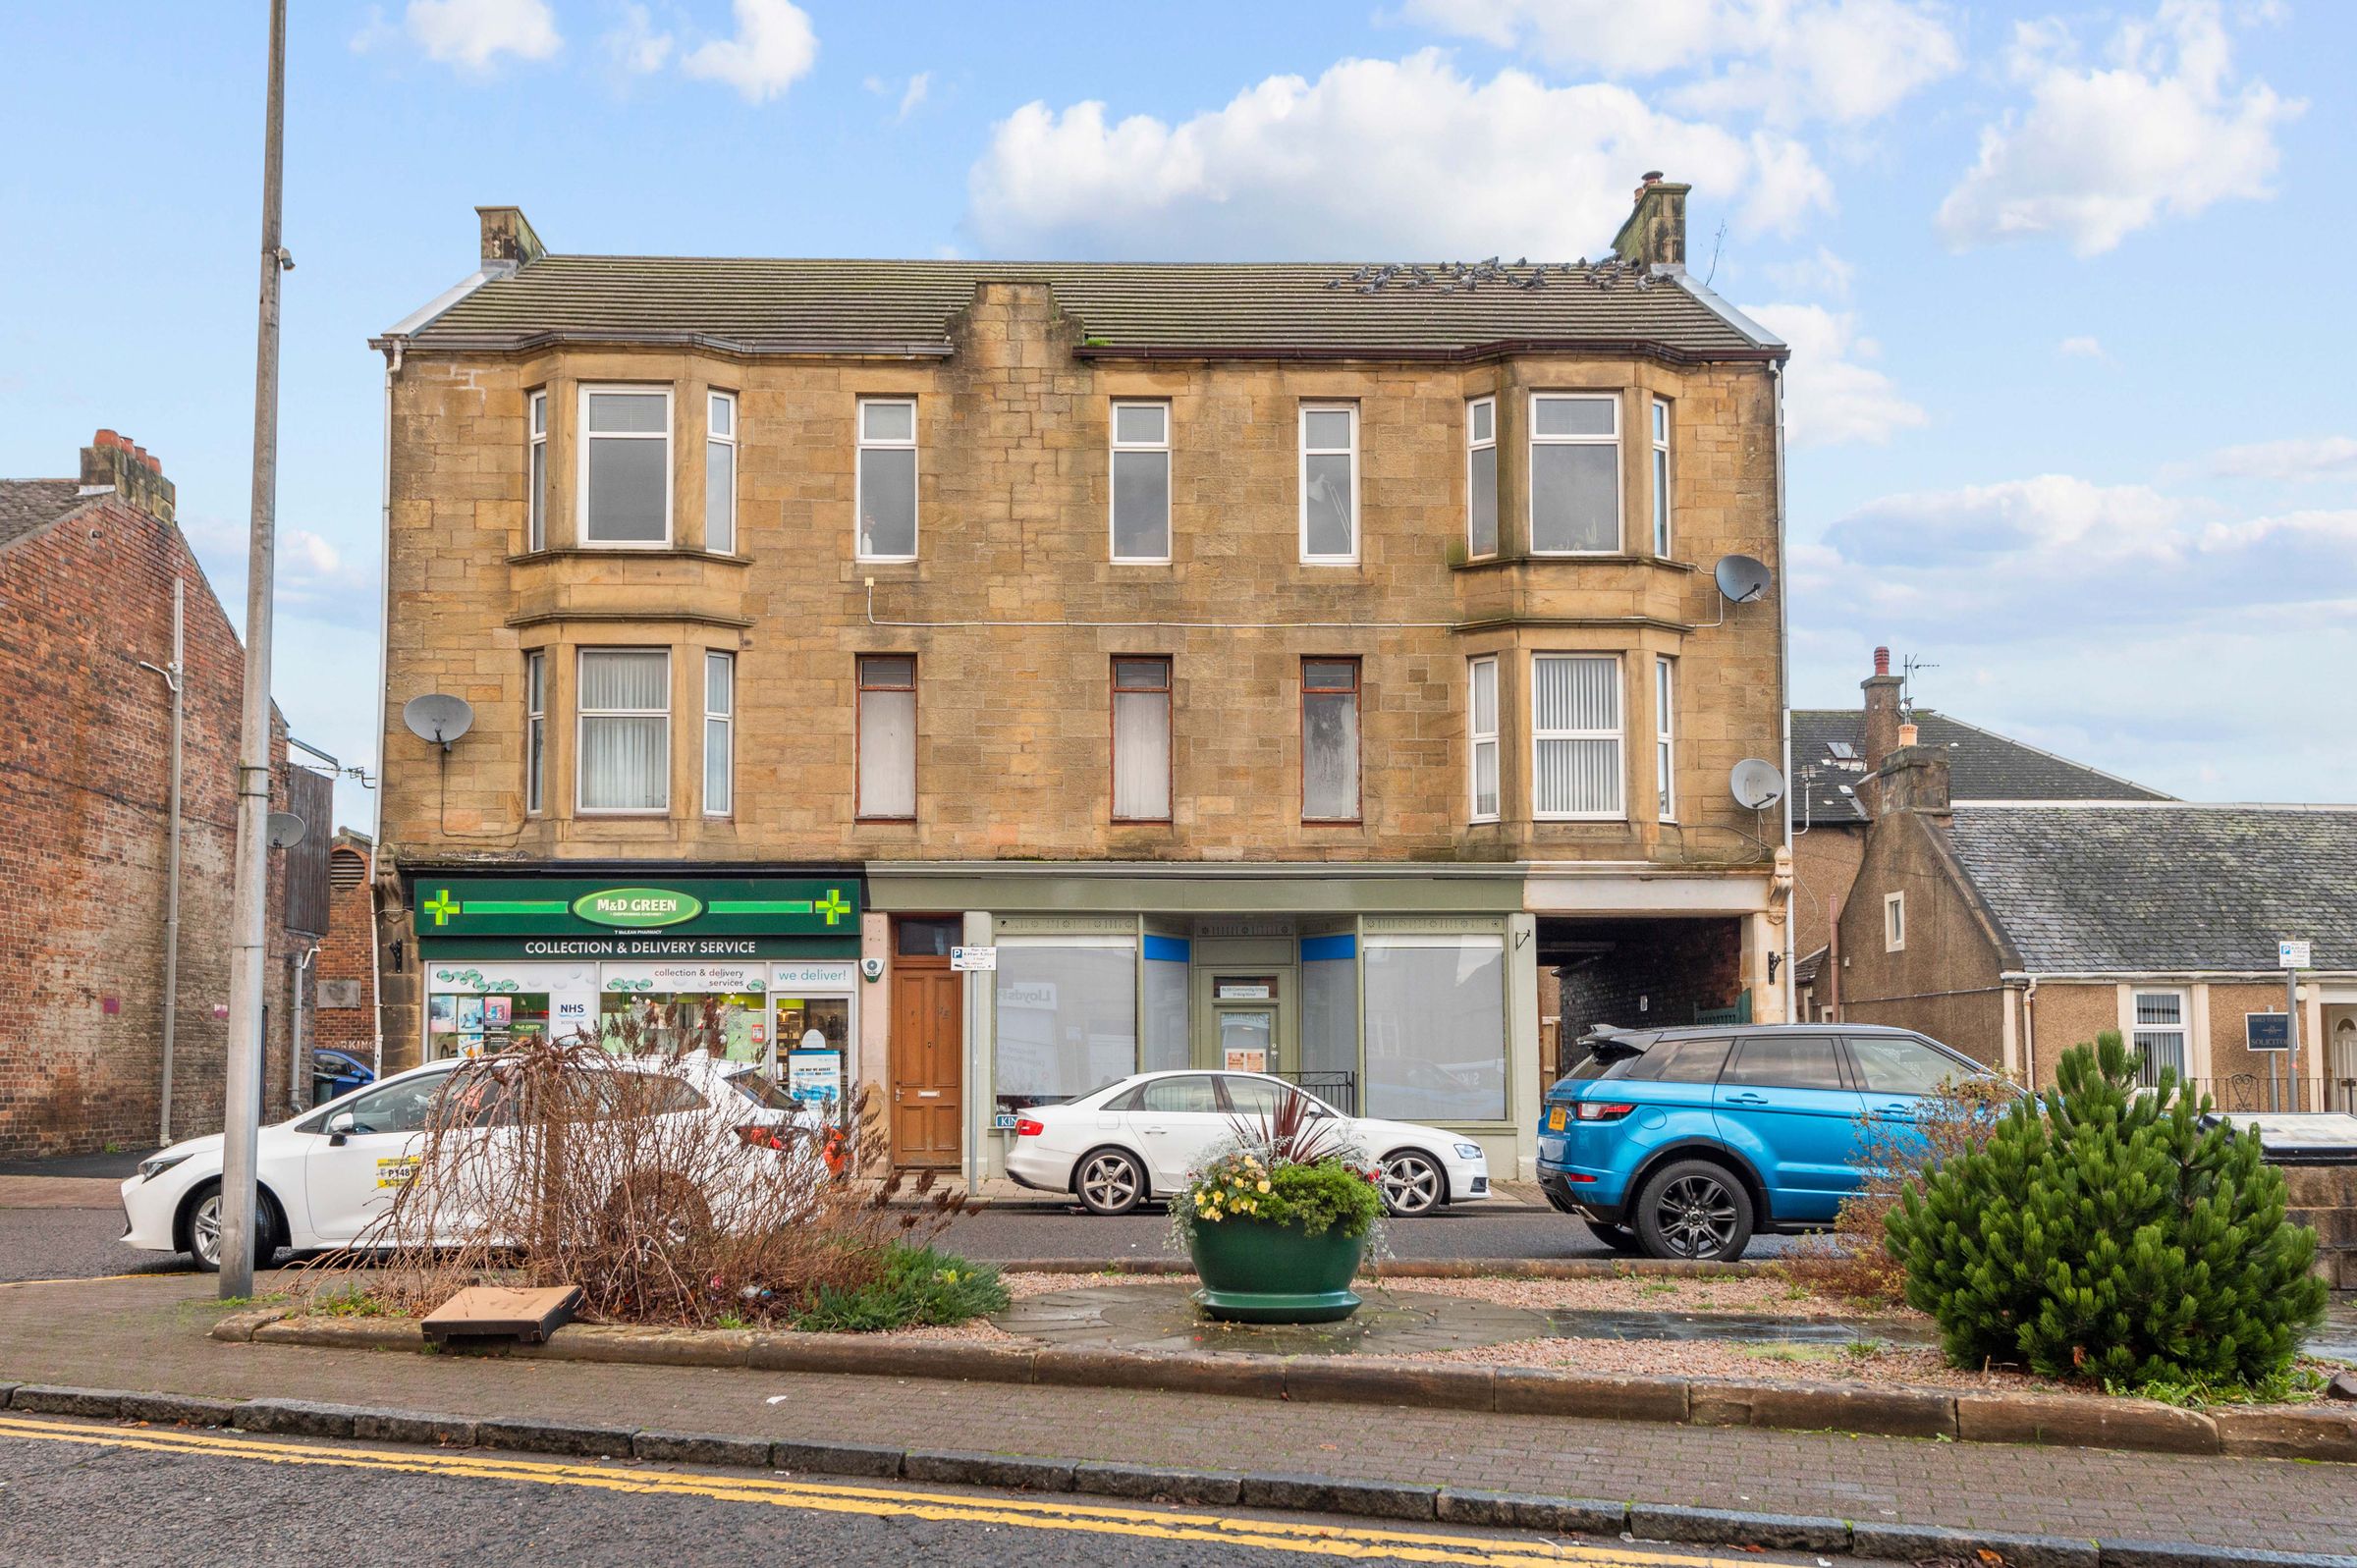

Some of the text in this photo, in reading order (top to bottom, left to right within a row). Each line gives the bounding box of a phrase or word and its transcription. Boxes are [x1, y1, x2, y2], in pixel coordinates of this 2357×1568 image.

[597, 898, 677, 912] M&D GREEN
[525, 942, 756, 954] COLLECTION & DELIVERY SERVICE
[954, 949, 960, 958] P
[655, 968, 696, 977] collection
[709, 968, 744, 980] delivery
[779, 969, 847, 981] we deliver!
[561, 1004, 584, 1013] NHS
